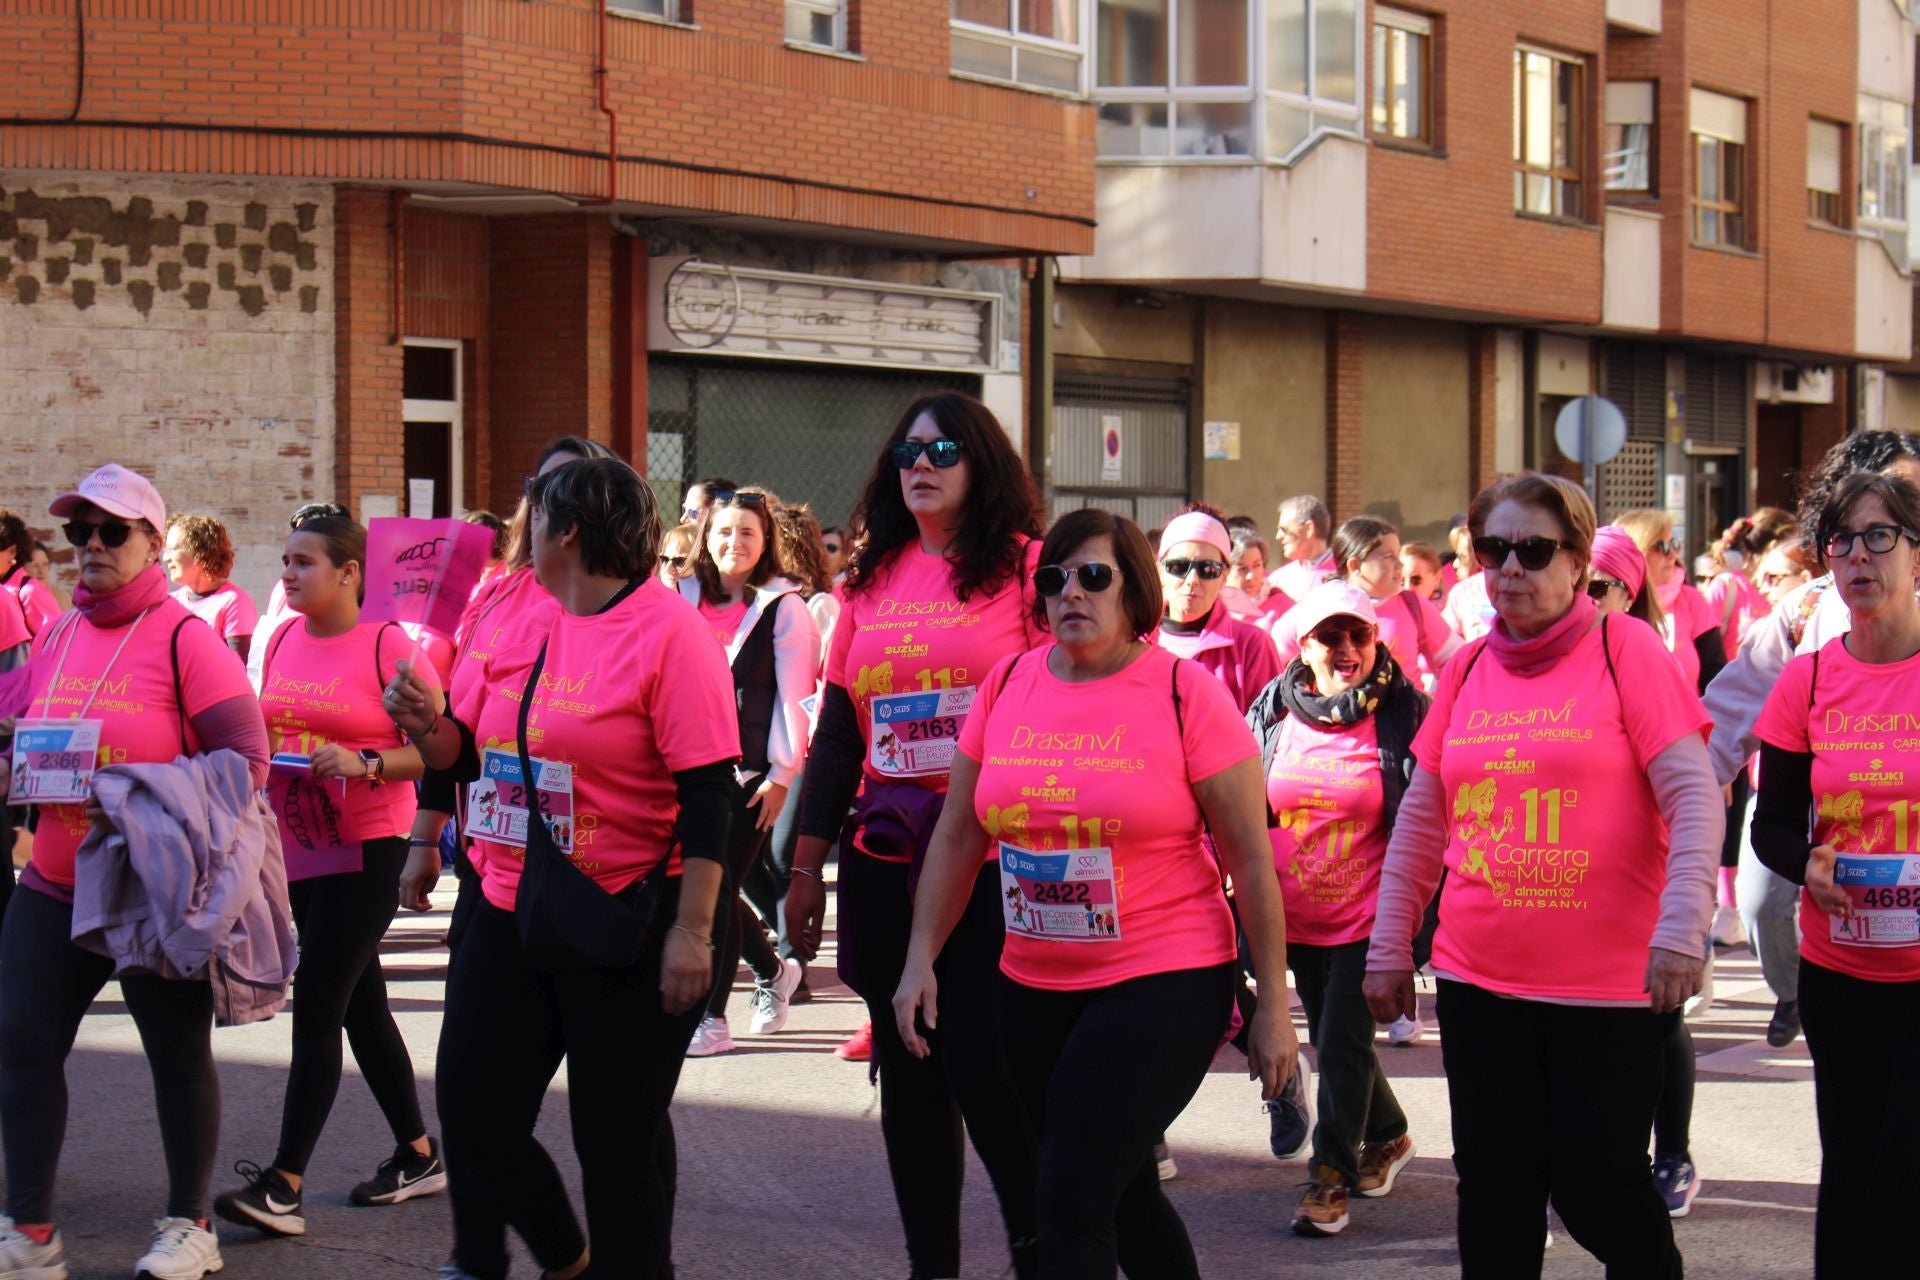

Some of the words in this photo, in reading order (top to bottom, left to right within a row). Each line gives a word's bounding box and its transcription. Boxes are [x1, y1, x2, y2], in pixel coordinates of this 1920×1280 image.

[885, 644, 928, 654] SUZUKI
[268, 671, 343, 697] Drasanvi
[547, 698, 597, 714] CAROBELS
[1467, 698, 1576, 730] Drasanvi
[908, 718, 957, 740] 2163
[1825, 709, 1920, 734] Drasanv
[1010, 724, 1128, 752] Drasanvi
[1528, 728, 1592, 740] CAROBELS
[39, 753, 81, 769] 2366
[1073, 757, 1145, 769] CAROBELS
[1484, 760, 1536, 770] SUZUKI
[1848, 772, 1904, 781] SUZUKI
[1021, 787, 1076, 798] SUZUKI
[1299, 797, 1337, 807] SUZUKI
[1494, 844, 1589, 866] Carrera
[1304, 856, 1367, 873] Carrera
[1318, 871, 1366, 887] Mujer
[1518, 865, 1588, 887] Mujer
[1034, 883, 1090, 903] 2422
[1515, 886, 1557, 897] almom
[1864, 888, 1920, 908] 4682
[1503, 899, 1588, 909] DRASANVI
